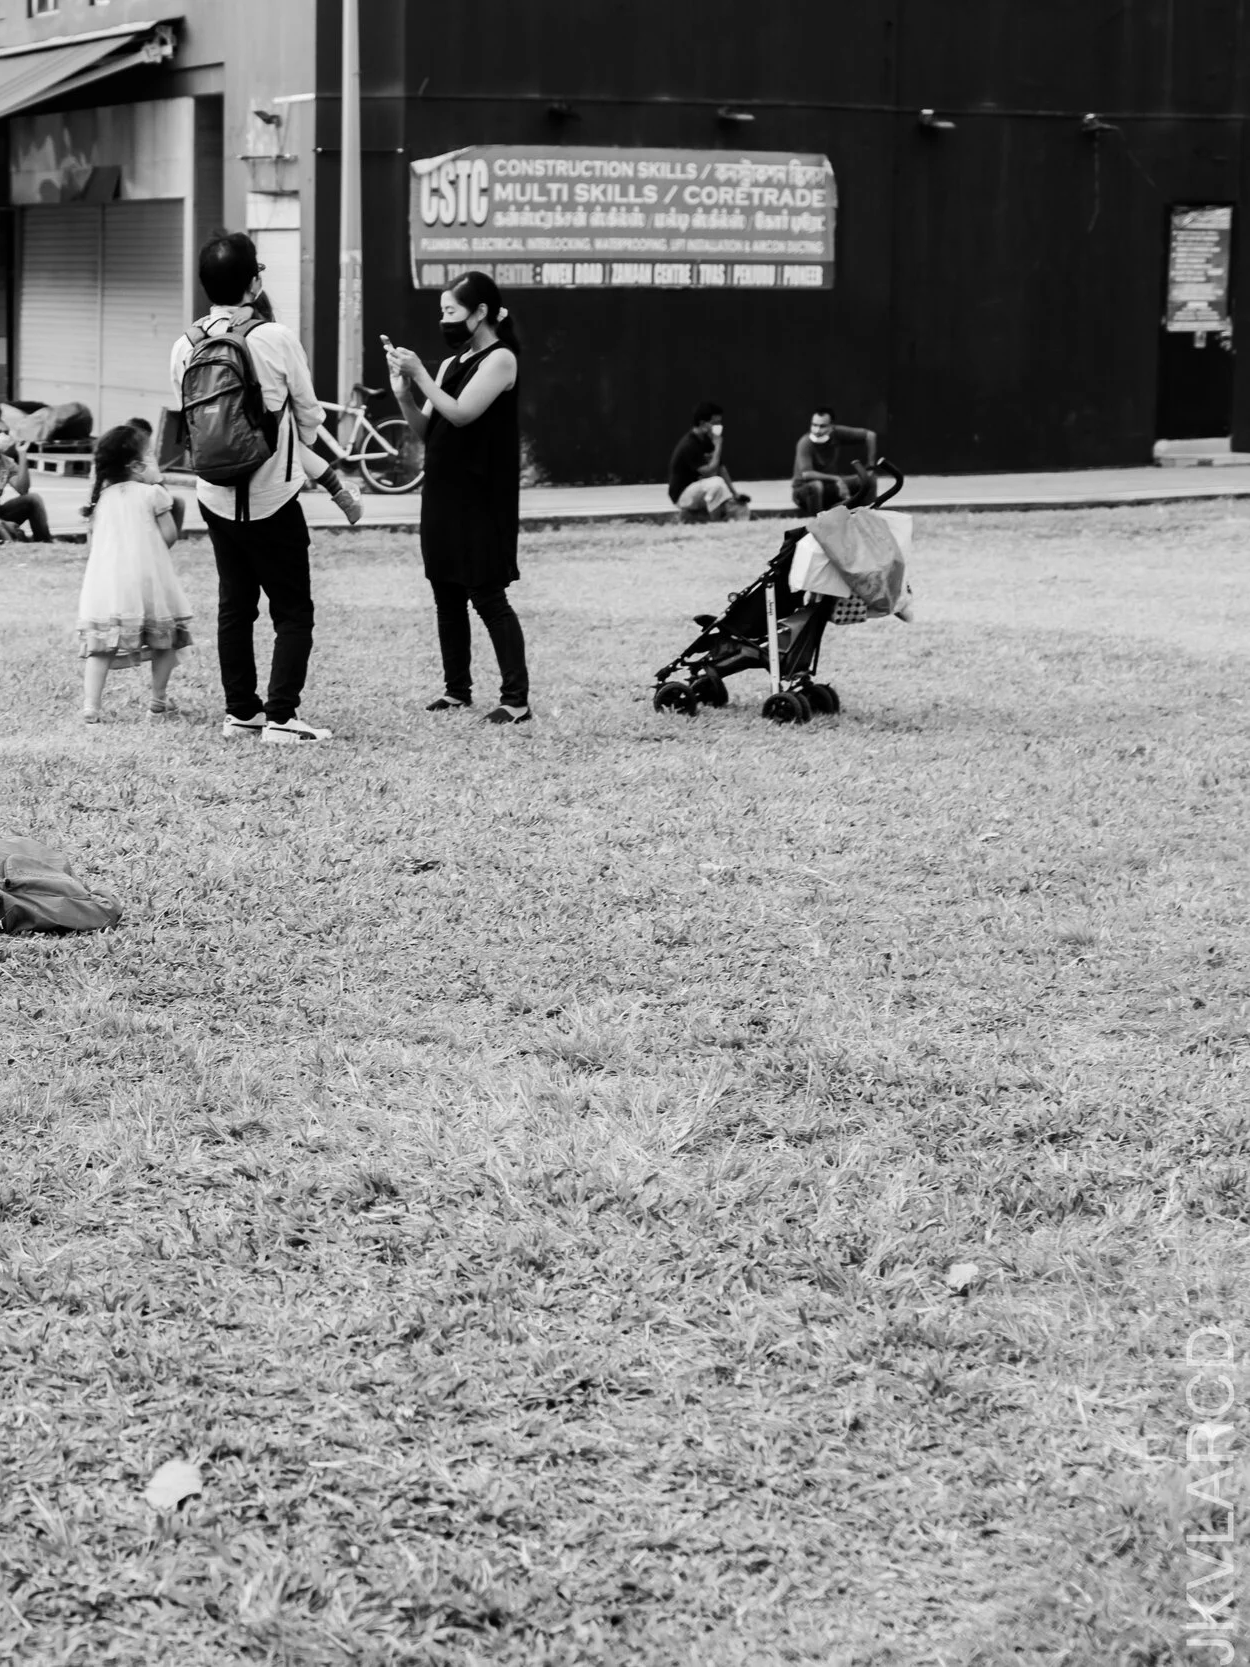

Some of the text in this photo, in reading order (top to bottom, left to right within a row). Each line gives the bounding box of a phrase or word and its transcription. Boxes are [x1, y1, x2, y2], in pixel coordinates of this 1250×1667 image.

[493, 159, 634, 179] CONSTRUCTION
[637, 161, 698, 180] SKILLS
[421, 159, 489, 225] CSTC
[493, 183, 569, 202] MULTI
[574, 183, 658, 204] SKILLS
[683, 185, 826, 208] CORETRADE
